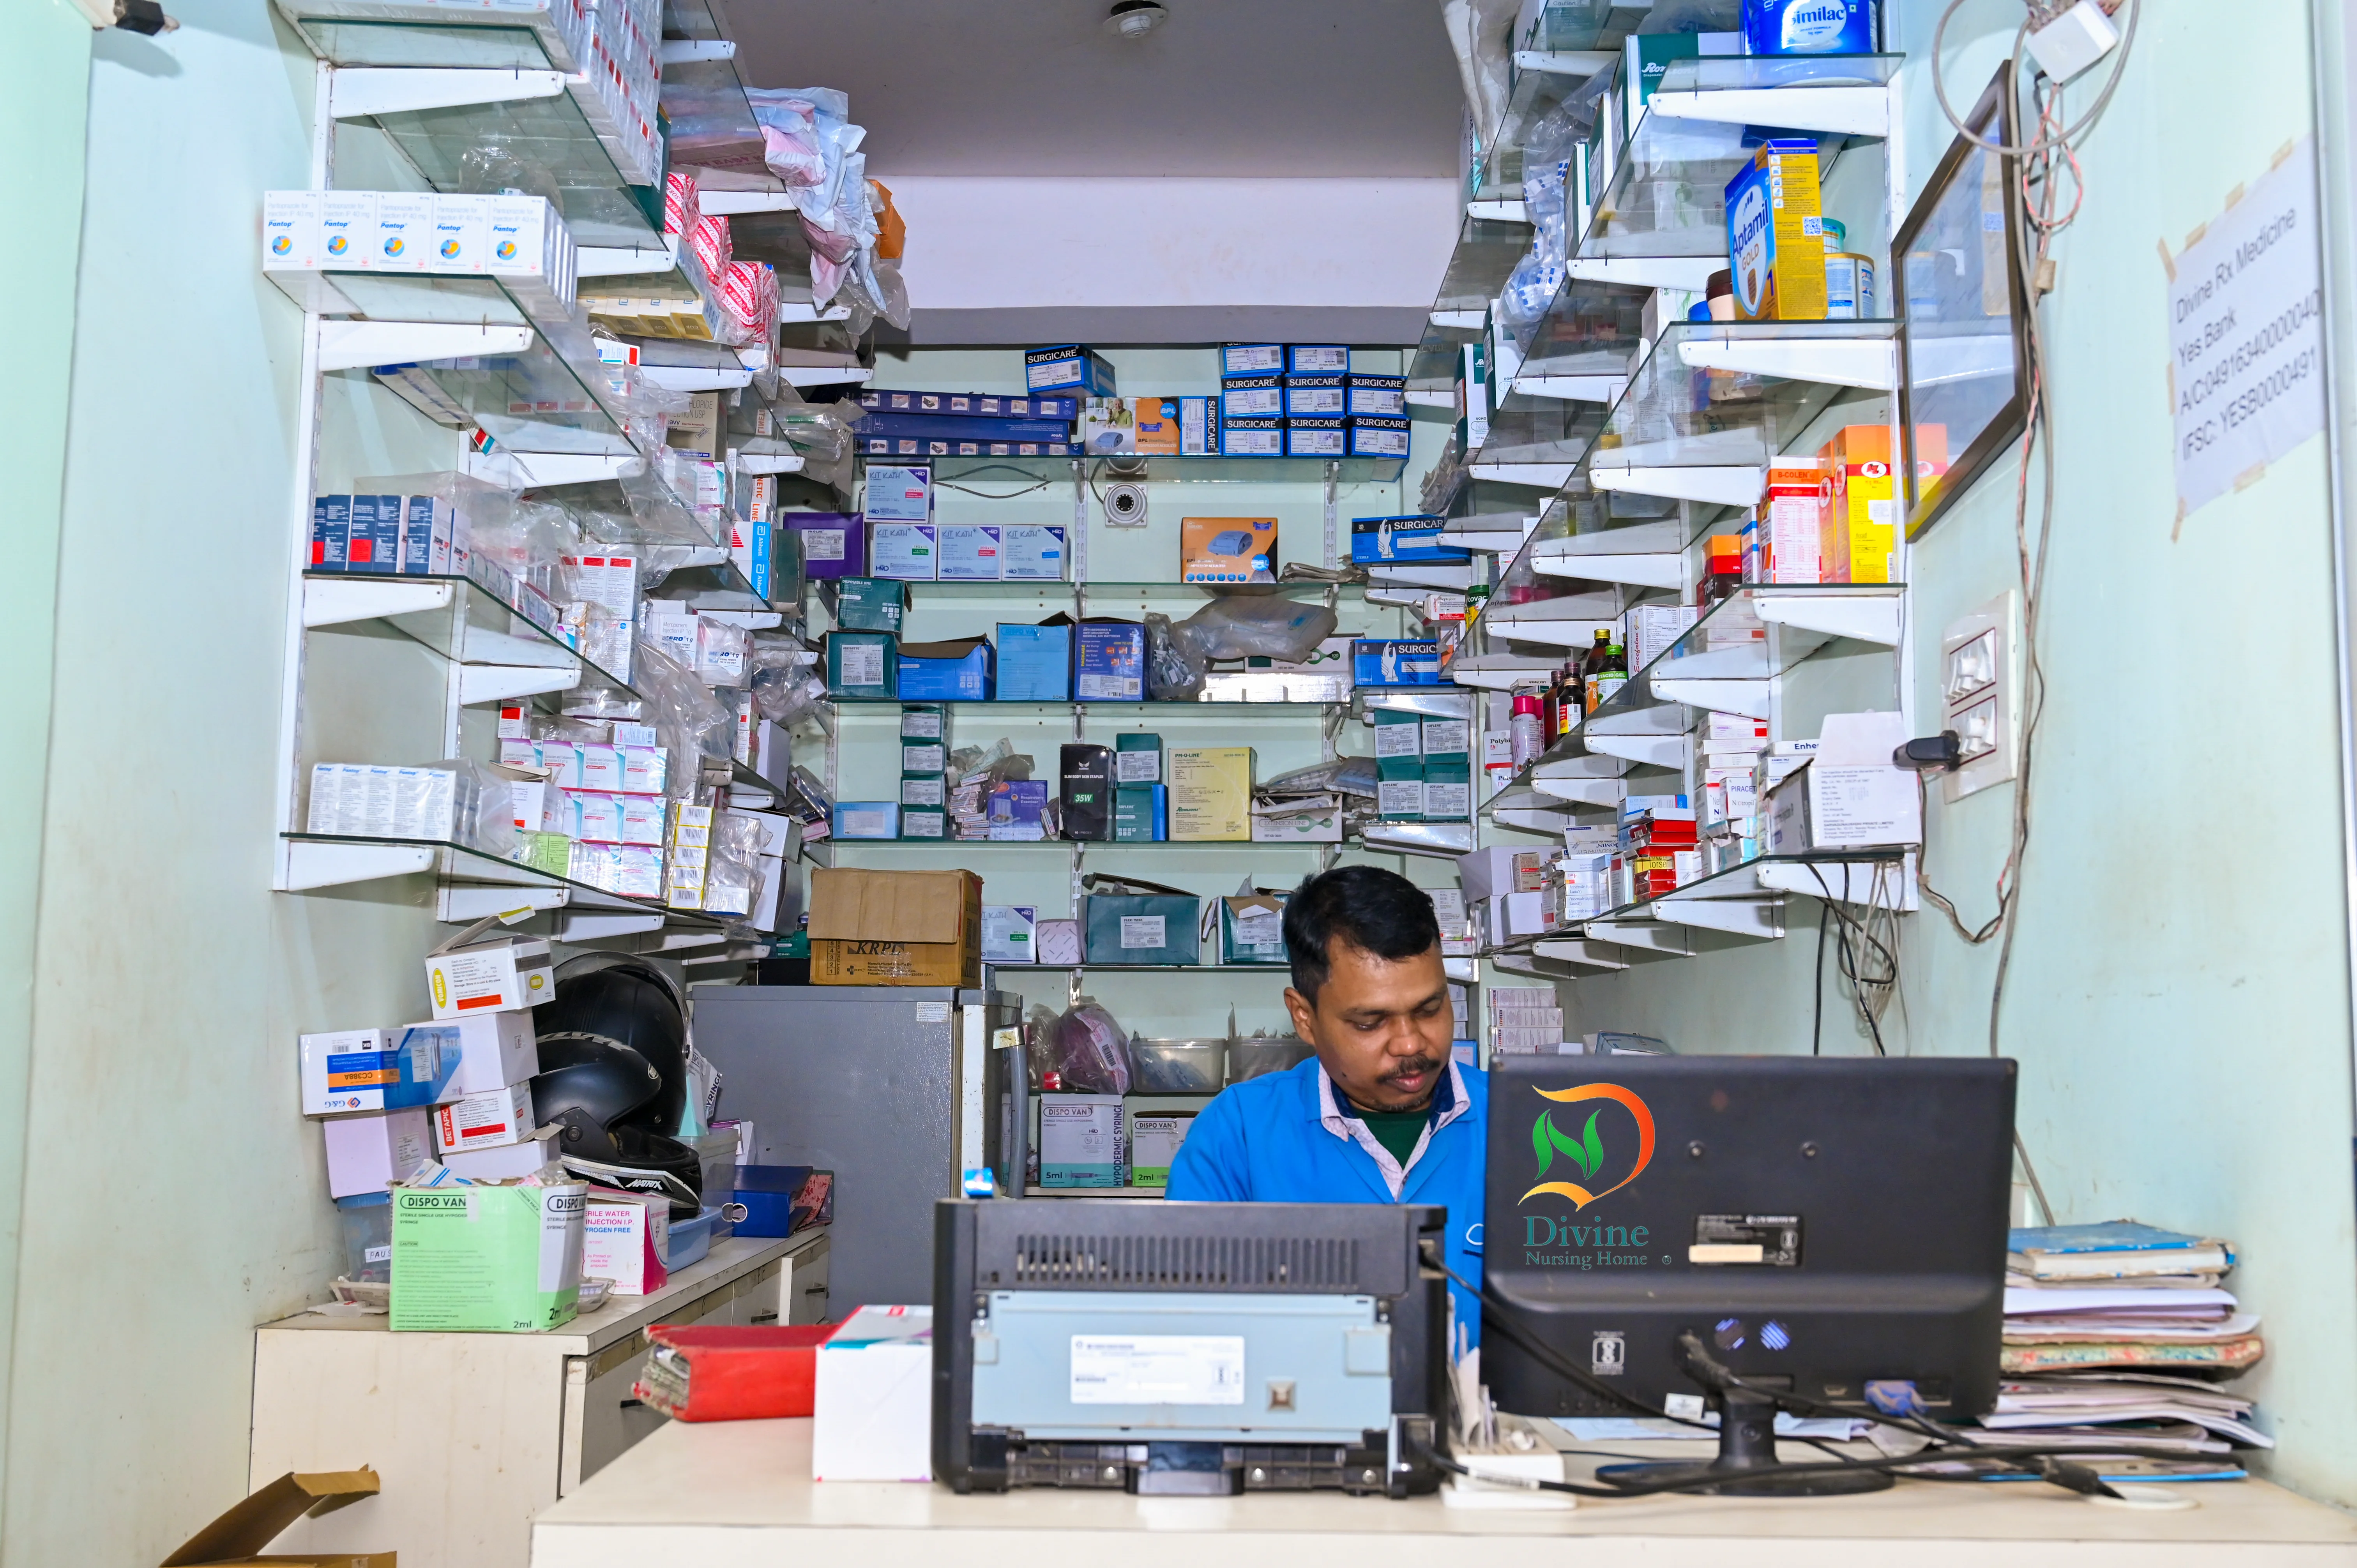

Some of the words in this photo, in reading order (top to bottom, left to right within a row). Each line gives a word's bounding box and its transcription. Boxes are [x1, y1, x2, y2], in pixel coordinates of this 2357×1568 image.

[698, 227, 711, 245] SHREE
[1733, 198, 1769, 260] Aptamil
[1742, 244, 1759, 270] GOLD
[2177, 280, 2212, 324] Divine
[2216, 262, 2233, 290] Rx
[2236, 208, 2296, 273] Medicine
[1767, 268, 1774, 297] 1
[2179, 337, 2202, 367] Yes
[2205, 306, 2237, 349] Bank
[1028, 349, 1077, 364] SURGICARE
[1226, 379, 1275, 389] SURGICARE
[1289, 378, 1339, 386] SURGICARE
[1352, 378, 1402, 388] SURGICARE
[2183, 419, 2217, 461] IFSC:
[2219, 345, 2317, 433] YESB0000491
[1356, 418, 1407, 428] SURGICARE
[752, 503, 760, 521] LINE
[1398, 645, 1437, 653] SURGIC
[436, 974, 445, 1002] VOMICON
[442, 1108, 453, 1142] BETAPIC
[1114, 1104, 1122, 1135] SYRINGE
[1114, 1137, 1122, 1186] HYPODERMIC
[625, 1179, 663, 1190] MATRIX
[408, 1198, 439, 1206] DISPO
[443, 1198, 466, 1206] VAN
[557, 1199, 578, 1208] DISPO
